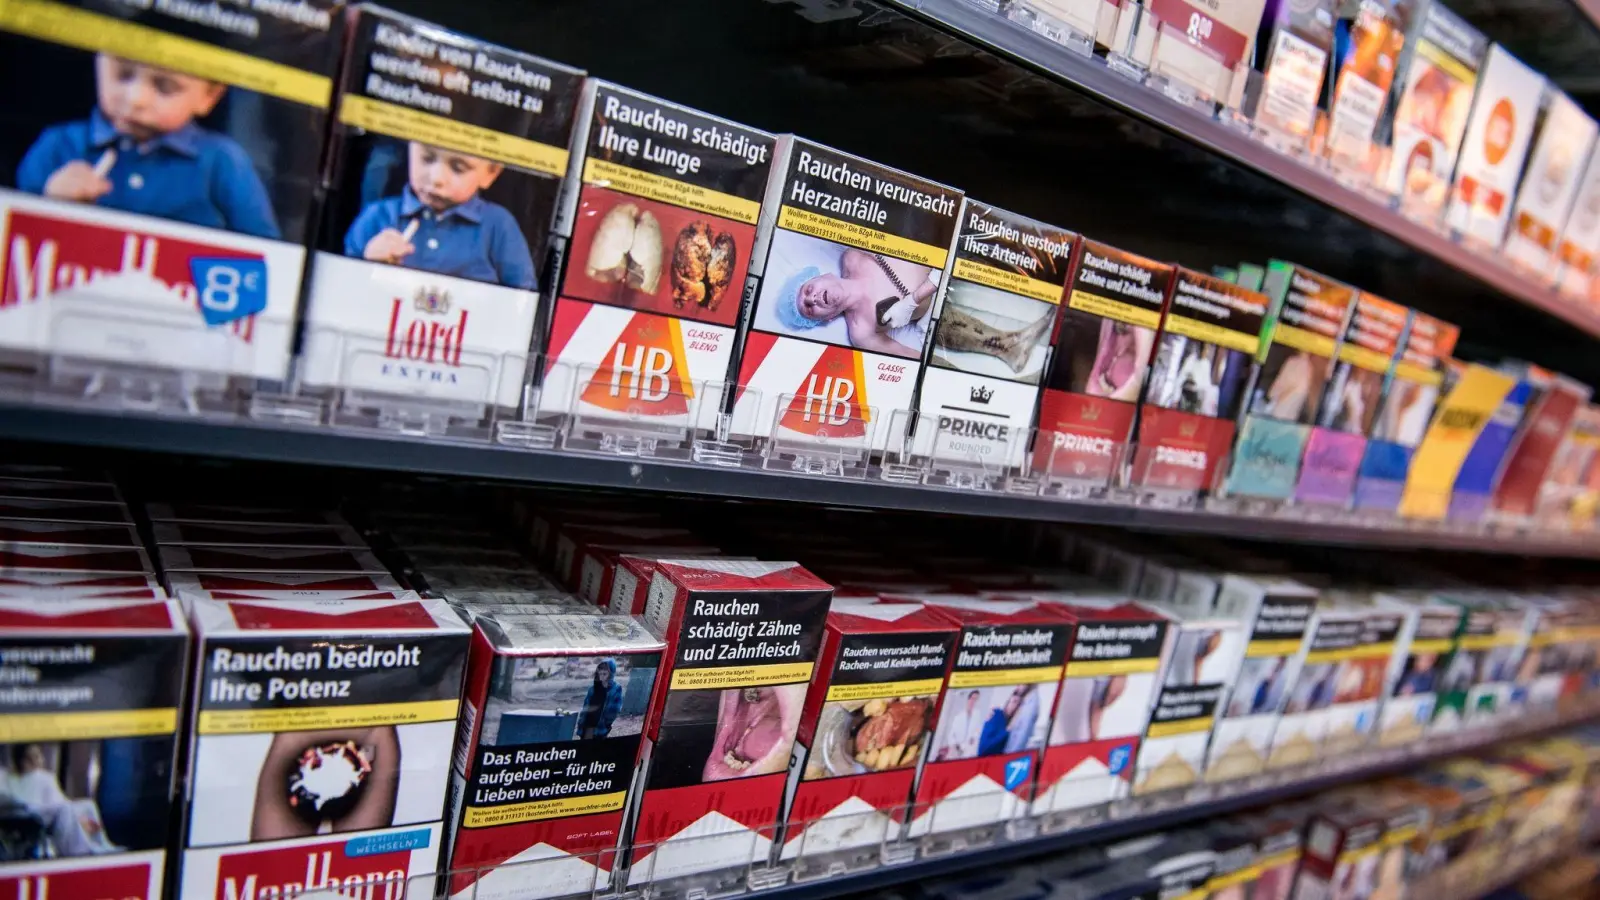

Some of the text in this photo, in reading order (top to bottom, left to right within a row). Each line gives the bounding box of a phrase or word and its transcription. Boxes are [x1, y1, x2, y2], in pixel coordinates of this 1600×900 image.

[439, 43, 472, 69] von
[474, 53, 552, 91] Rauchern
[366, 73, 453, 114] Rauchern
[443, 71, 470, 93] oft
[471, 80, 522, 105] selbst
[522, 96, 543, 114] zu
[604, 96, 767, 165] Rauchen schädigt
[599, 125, 701, 175] Ihre Lunge
[798, 151, 955, 217] Rauchen verursacht
[791, 180, 887, 226] Herzanfälle
[809, 213, 818, 223] Sie
[848, 224, 859, 234] Die
[858, 227, 874, 240] BZgA
[969, 213, 1070, 260] Rauchen verstopft
[871, 243, 929, 264] www.rauchfrei-info.de
[964, 235, 1037, 271] Ihre Arterien
[1084, 252, 1119, 274] Rauchen
[1079, 268, 1106, 288] Zähne
[1106, 278, 1122, 293] und
[385, 297, 468, 367] Lord
[687, 328, 723, 342] CLASSIC
[688, 341, 718, 353] BLEND
[381, 363, 458, 384] EXTRA
[609, 341, 675, 402] HB
[877, 362, 907, 375] CLASSIC
[878, 373, 902, 383] BLEND
[803, 373, 855, 426] HB
[939, 417, 1010, 443] PRINCE
[947, 441, 992, 455] ROUNDED
[1053, 431, 1114, 456] PRINCE
[693, 599, 760, 616] Rauchen
[688, 620, 802, 642] schädigt Zähne
[963, 629, 1054, 648] Rauchen mindert
[213, 645, 421, 672] Rauchen bedroht
[683, 641, 801, 661] und Zahnfleisch
[843, 647, 878, 657] Rauchen
[879, 645, 919, 656] verursacht
[957, 648, 1053, 667] Ihre Fruchtbarkeit
[839, 656, 943, 671] Rachen- und Kehlkopfkrebs
[210, 677, 352, 701] Ihre Potenz
[483, 747, 577, 766] Das Rauchen
[479, 767, 550, 787] aufgeben
[566, 764, 586, 778] für
[589, 760, 616, 774] Ihre
[475, 779, 612, 803] Lieben weiterleben
[356, 839, 418, 854] WECHSELN?
[566, 830, 614, 841] SOFT LABEL
